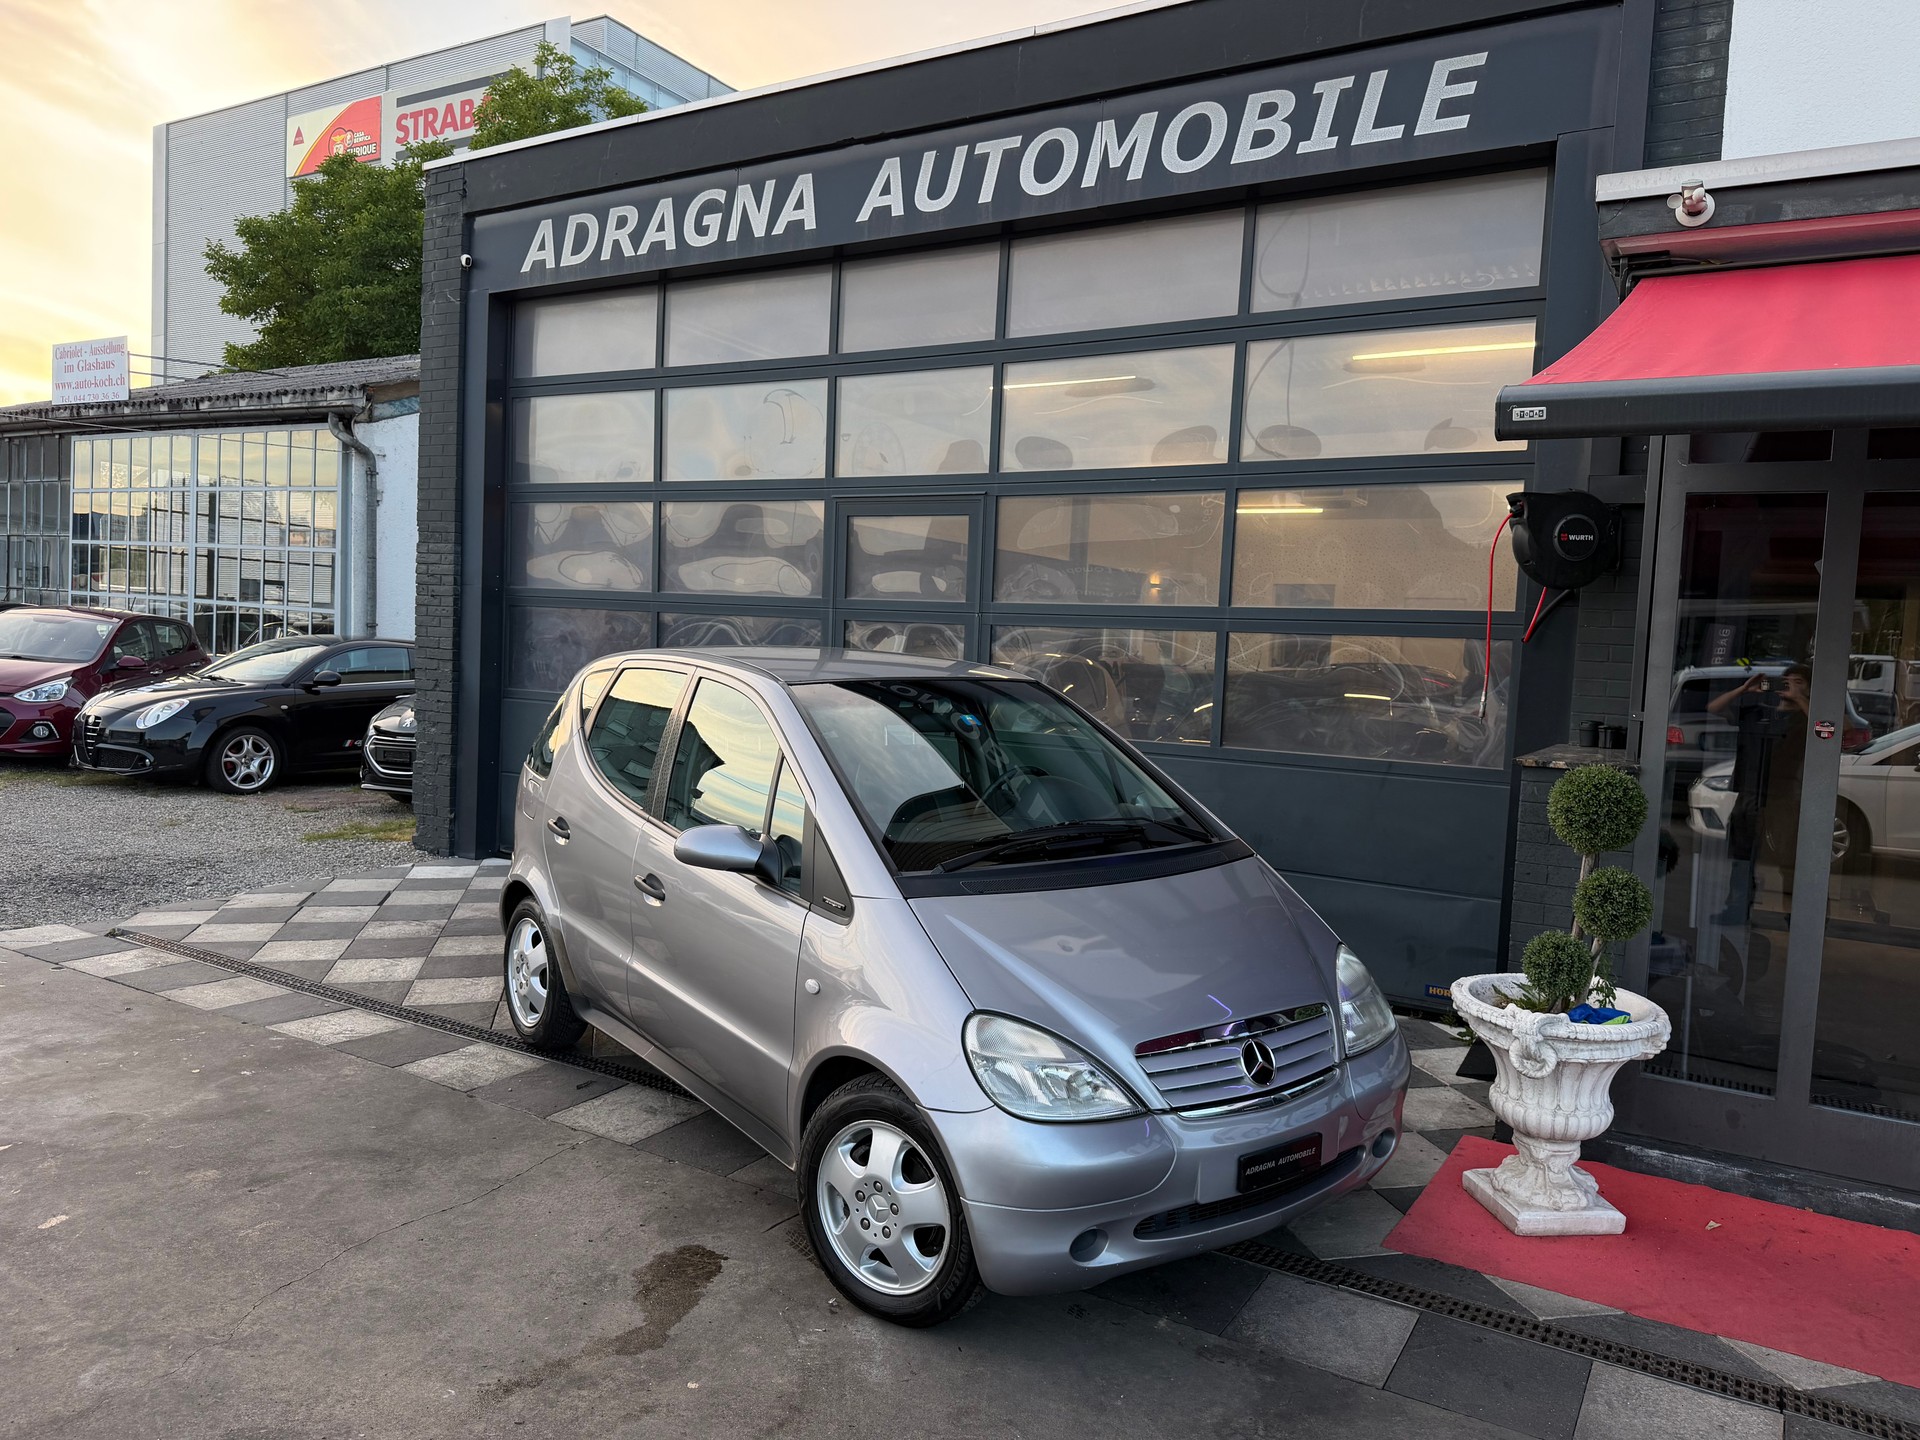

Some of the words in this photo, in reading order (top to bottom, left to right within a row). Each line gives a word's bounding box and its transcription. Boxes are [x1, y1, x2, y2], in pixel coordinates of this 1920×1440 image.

[520, 172, 817, 274] ADRAGNA
[856, 52, 1488, 223] AUTOMOBILE
[55, 345, 83, 360] Cabriolet
[89, 341, 125, 356] Ausstellung
[64, 361, 75, 373] im
[77, 358, 115, 372] Glashaus
[55, 374, 126, 391] www.auto-koch.ch
[1428, 986, 1452, 998] HOR
[1245, 1160, 1276, 1176] ADRAGNA
[1278, 1146, 1316, 1166] AUTOMOBILE
